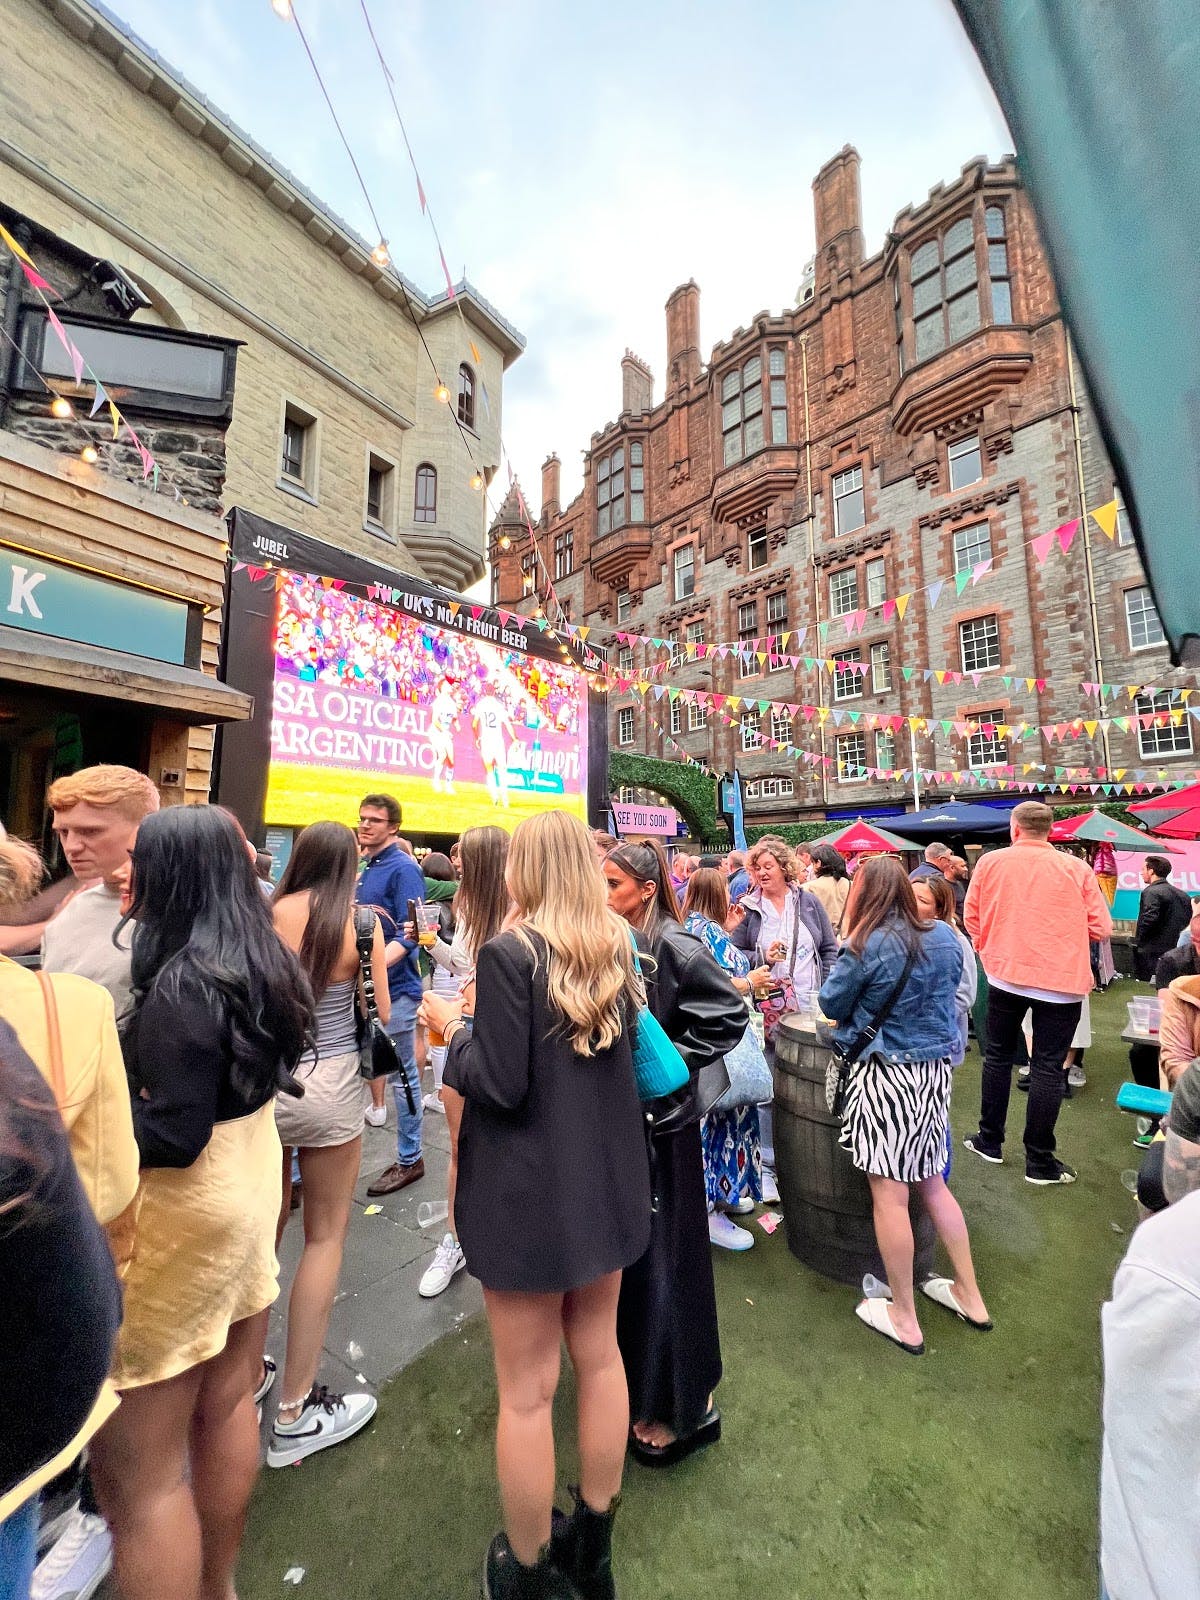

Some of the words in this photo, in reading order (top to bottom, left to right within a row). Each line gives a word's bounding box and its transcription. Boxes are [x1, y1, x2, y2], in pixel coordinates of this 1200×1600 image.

[252, 535, 289, 559] JUBEL
[7, 564, 46, 619] K
[437, 604, 463, 629] NO.1
[466, 616, 500, 641] FRUIT
[501, 631, 528, 650] BEER
[322, 691, 433, 737] OFICIAL
[484, 711, 497, 728] 12
[271, 719, 440, 770] ARGENTINO
[617, 811, 631, 825] SEE
[633, 812, 647, 826] YOU
[649, 814, 667, 828] SOON
